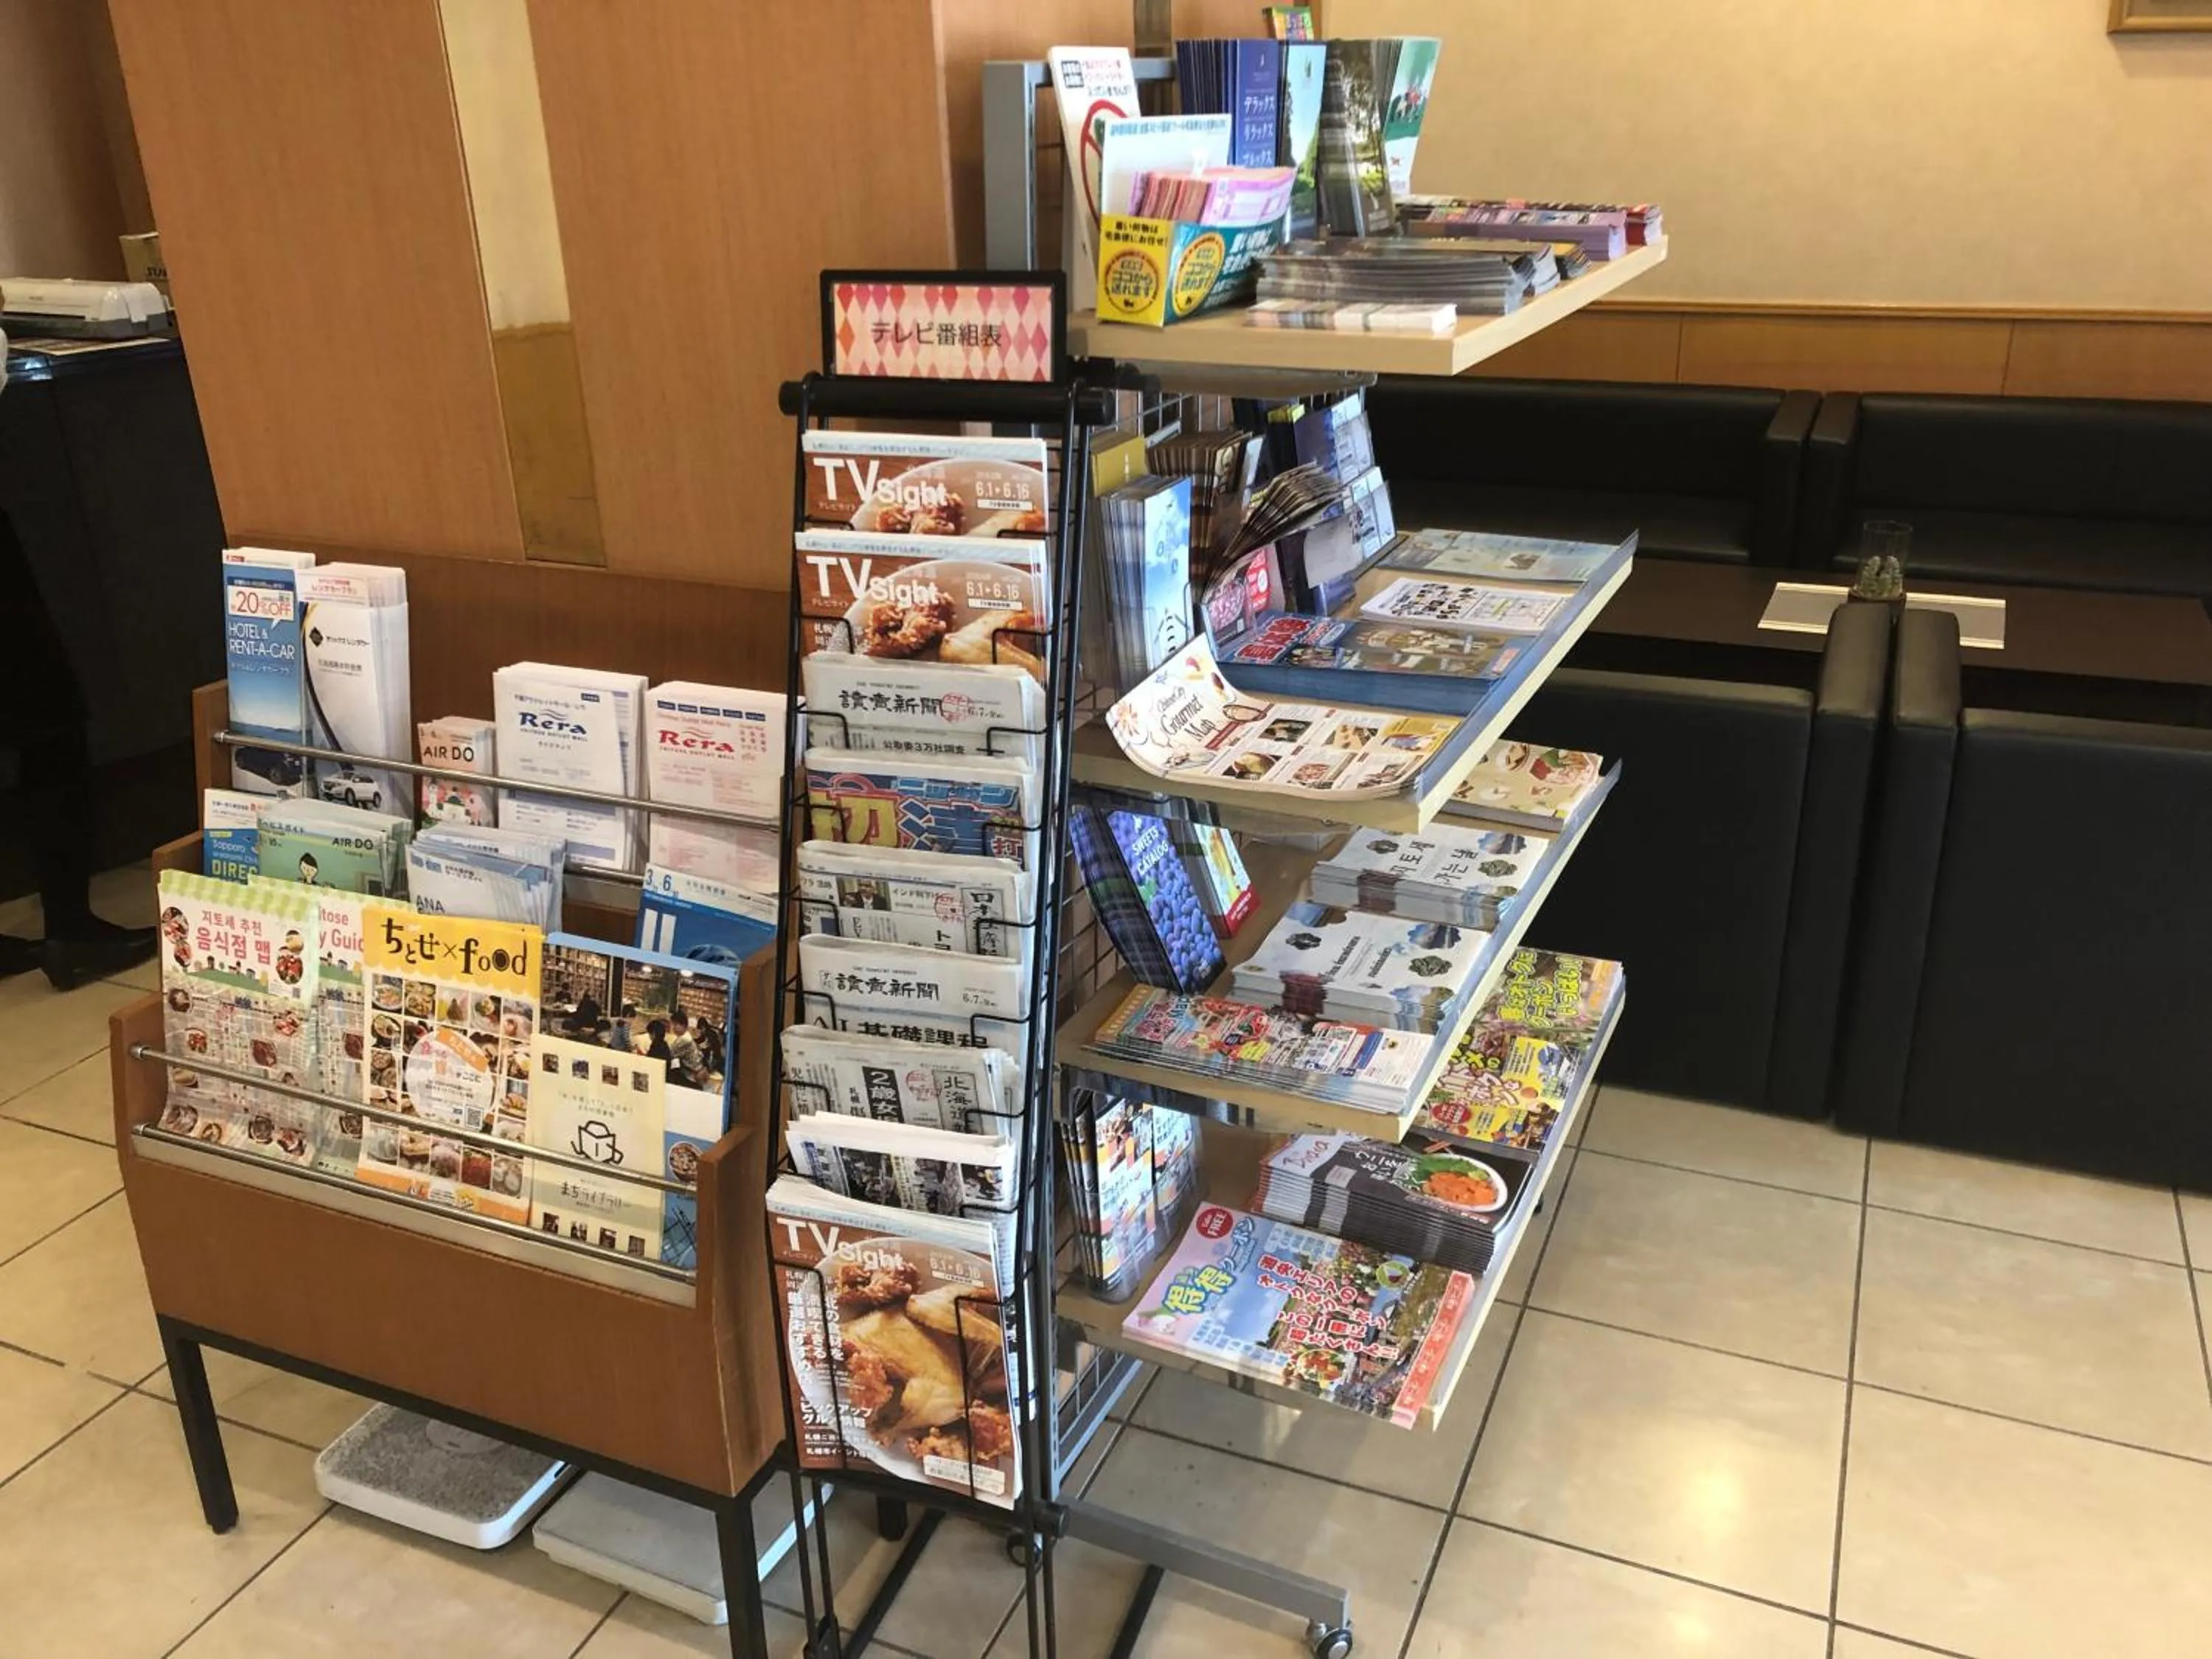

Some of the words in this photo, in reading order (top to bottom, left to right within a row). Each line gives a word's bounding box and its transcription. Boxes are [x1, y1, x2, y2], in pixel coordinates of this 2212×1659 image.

[871, 321, 1003, 347] テレビ番組表
[228, 622, 260, 640] HOTEL
[229, 640, 296, 660] RENT-A-CAR
[518, 711, 587, 735] Rera
[658, 729, 734, 753] Rera
[422, 745, 448, 759] AIR
[451, 746, 475, 762] DO
[333, 837, 351, 847] AIR
[354, 838, 374, 850] DO
[1131, 826, 1160, 856] SWEETS
[1136, 841, 1169, 874] CATALOG
[415, 894, 445, 915] ANA
[195, 927, 248, 959] 음식점
